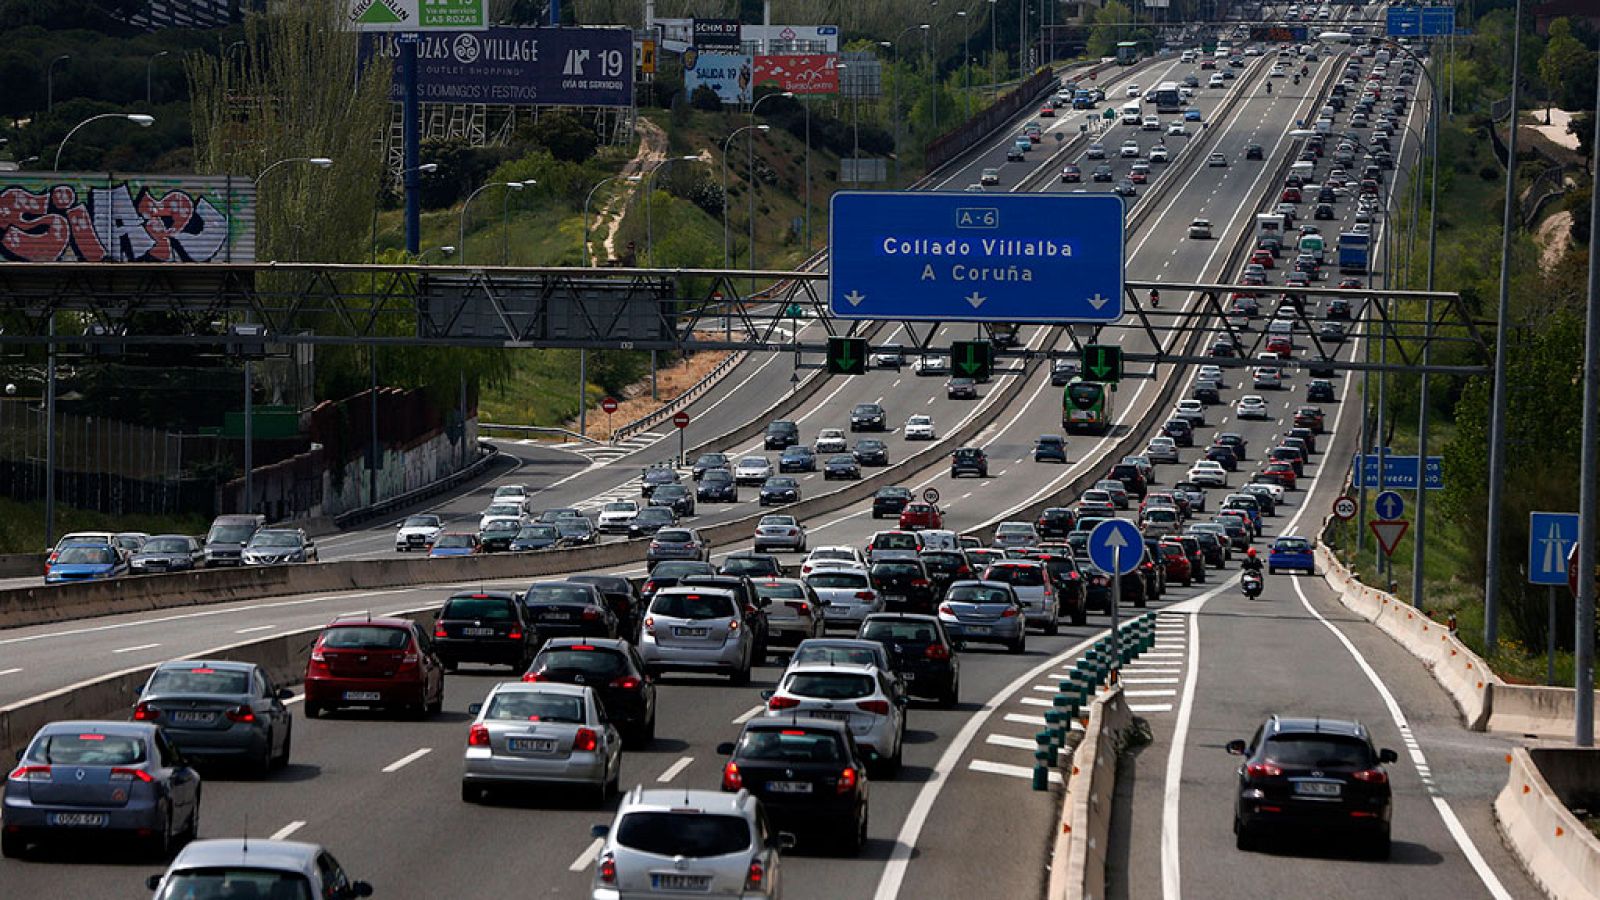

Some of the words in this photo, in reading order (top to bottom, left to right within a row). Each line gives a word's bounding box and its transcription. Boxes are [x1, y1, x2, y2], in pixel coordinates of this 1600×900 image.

[447, 15, 478, 24] ROZAS
[484, 39, 538, 61] VILLAGE
[598, 50, 623, 76] 19
[696, 68, 725, 79] SALIDA
[727, 68, 737, 79] 19
[427, 84, 481, 98] DOMINGOS
[481, 85, 490, 98] Y
[491, 86, 537, 99] FESTIVOS
[960, 211, 994, 226] A-6
[883, 237, 970, 256] Collado
[982, 238, 1072, 257] Villalba
[921, 264, 936, 280] A
[952, 264, 1033, 281] Coruña
